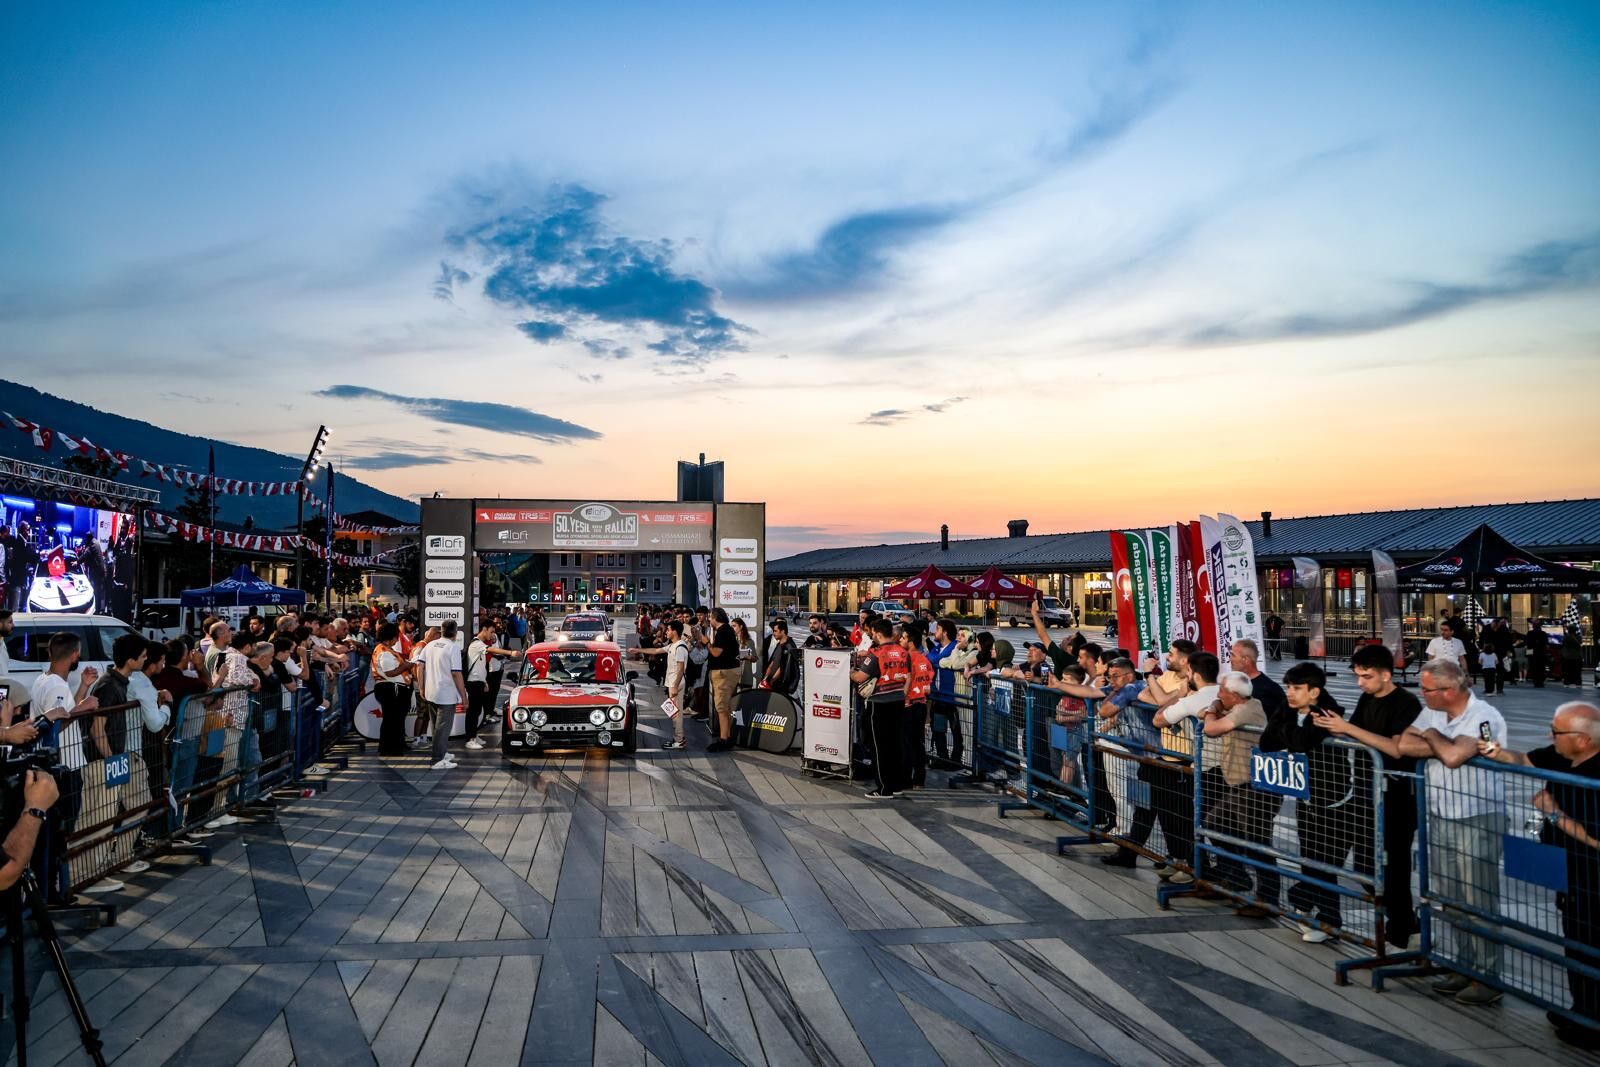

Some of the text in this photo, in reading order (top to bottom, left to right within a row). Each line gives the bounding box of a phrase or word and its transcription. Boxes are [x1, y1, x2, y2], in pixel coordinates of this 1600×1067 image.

[429, 612, 459, 620] bidijital
[752, 711, 788, 726] maxima
[814, 706, 831, 717] TRS
[106, 756, 129, 781] POLİS
[1253, 754, 1306, 791] POLİS
